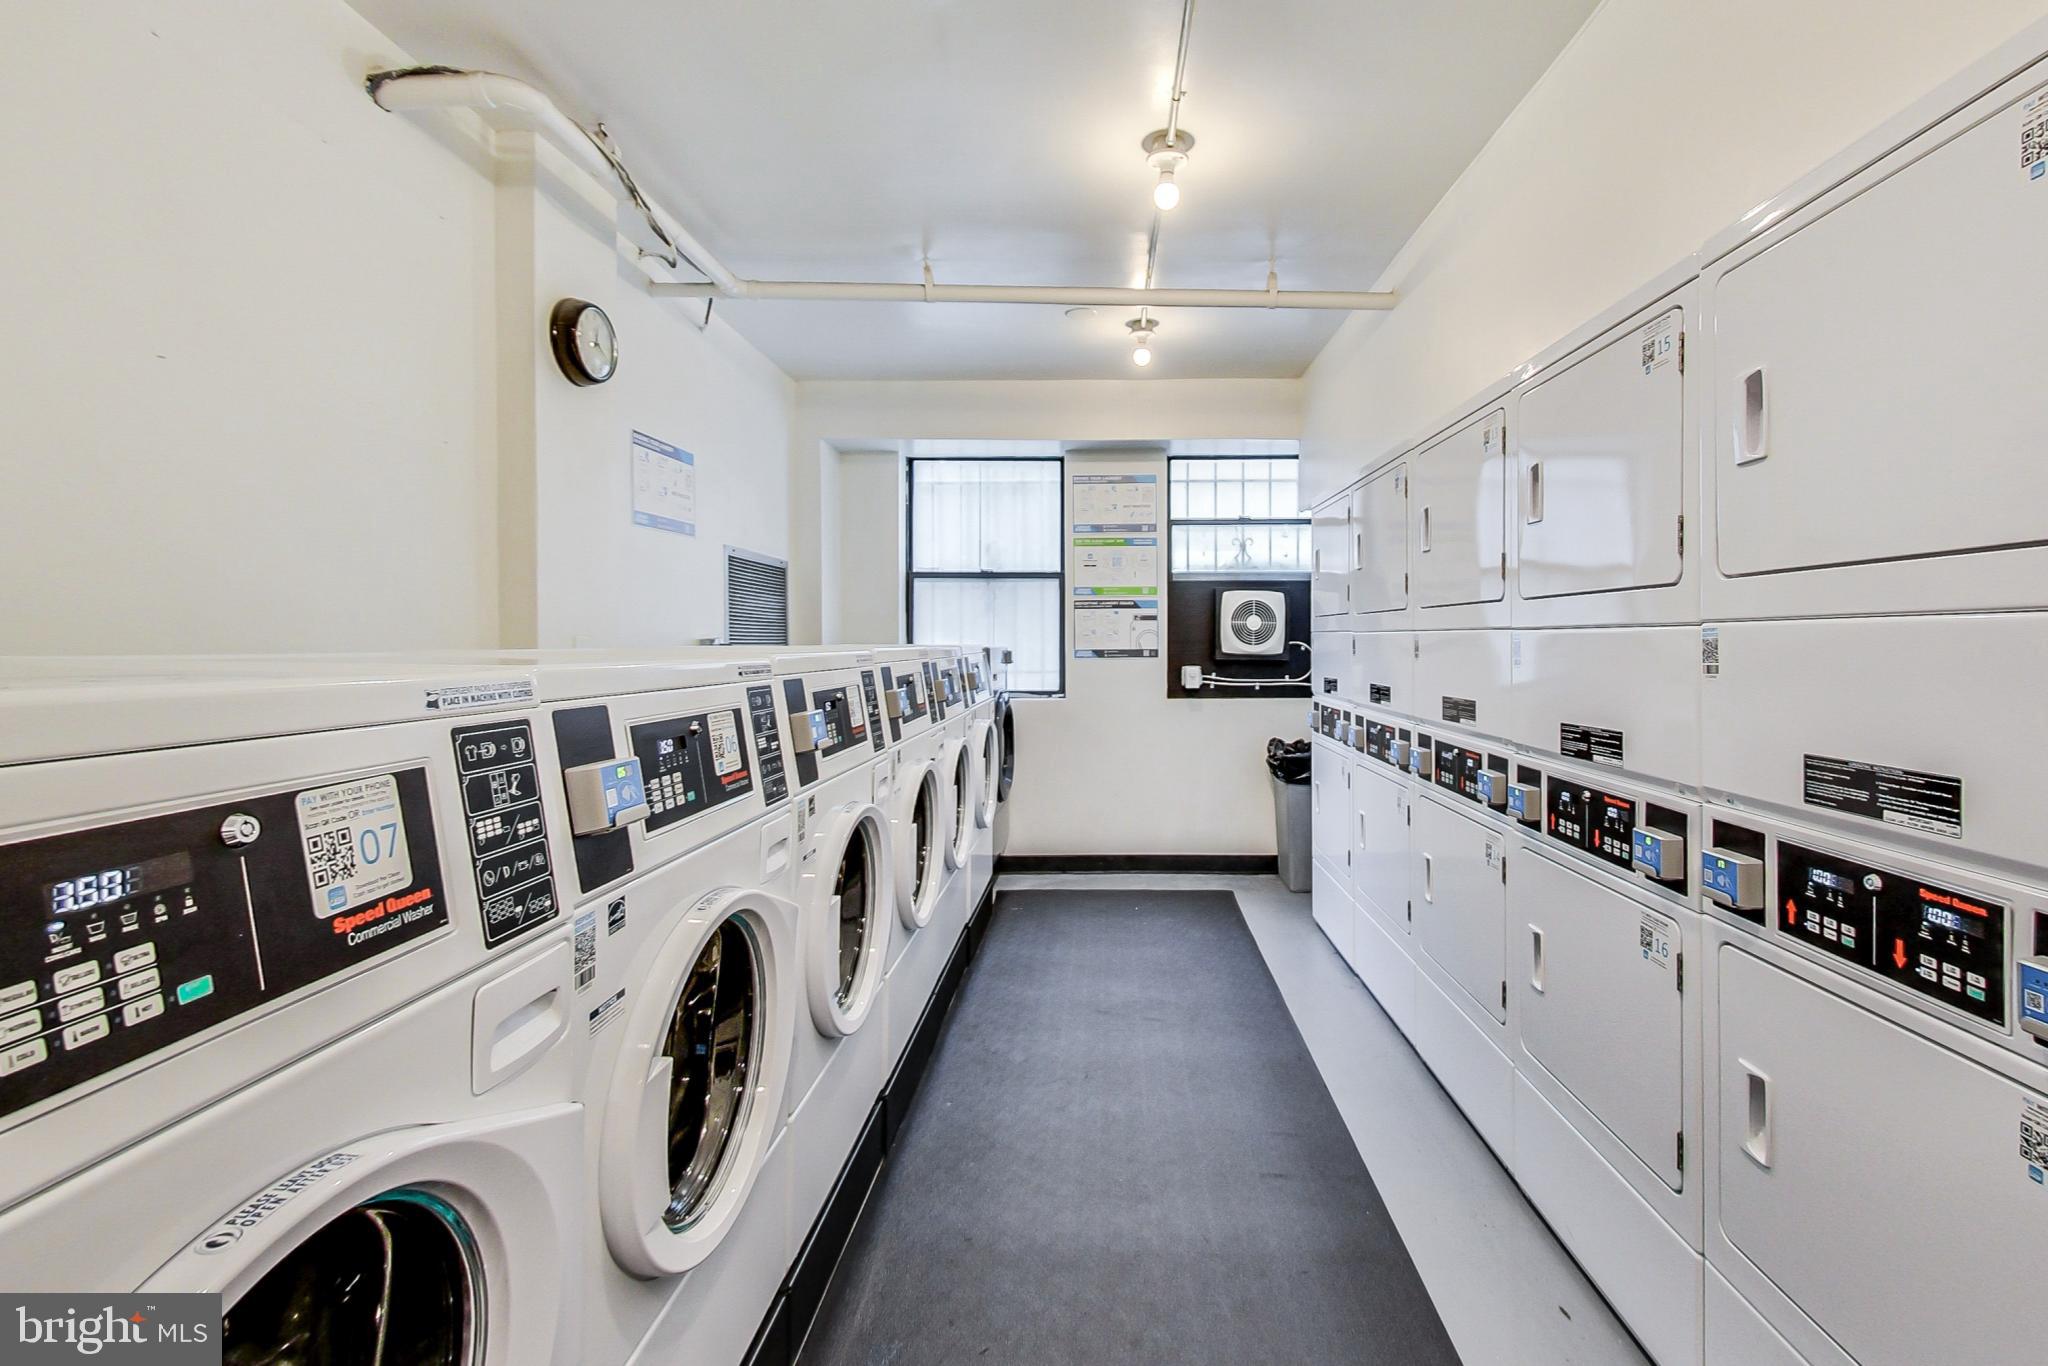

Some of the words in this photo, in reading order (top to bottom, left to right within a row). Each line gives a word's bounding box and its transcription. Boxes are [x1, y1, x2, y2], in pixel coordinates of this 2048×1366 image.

[1658, 335, 1671, 355] 15
[442, 696, 460, 706] PLACE
[301, 795, 317, 806] PAY
[320, 790, 340, 801] WITH
[341, 785, 363, 797] YOUR
[364, 779, 391, 792] PHONE
[360, 822, 398, 865] 07
[332, 902, 384, 934] Speed
[386, 888, 432, 913] Queen
[347, 914, 402, 946] Commercial
[402, 903, 434, 924] Washer
[1654, 938, 1669, 958] 16
[224, 1193, 277, 1226] PLEASE
[274, 1170, 313, 1191] LEAVE
[240, 1198, 287, 1227] OPEN
[288, 1167, 331, 1193] AFTER
